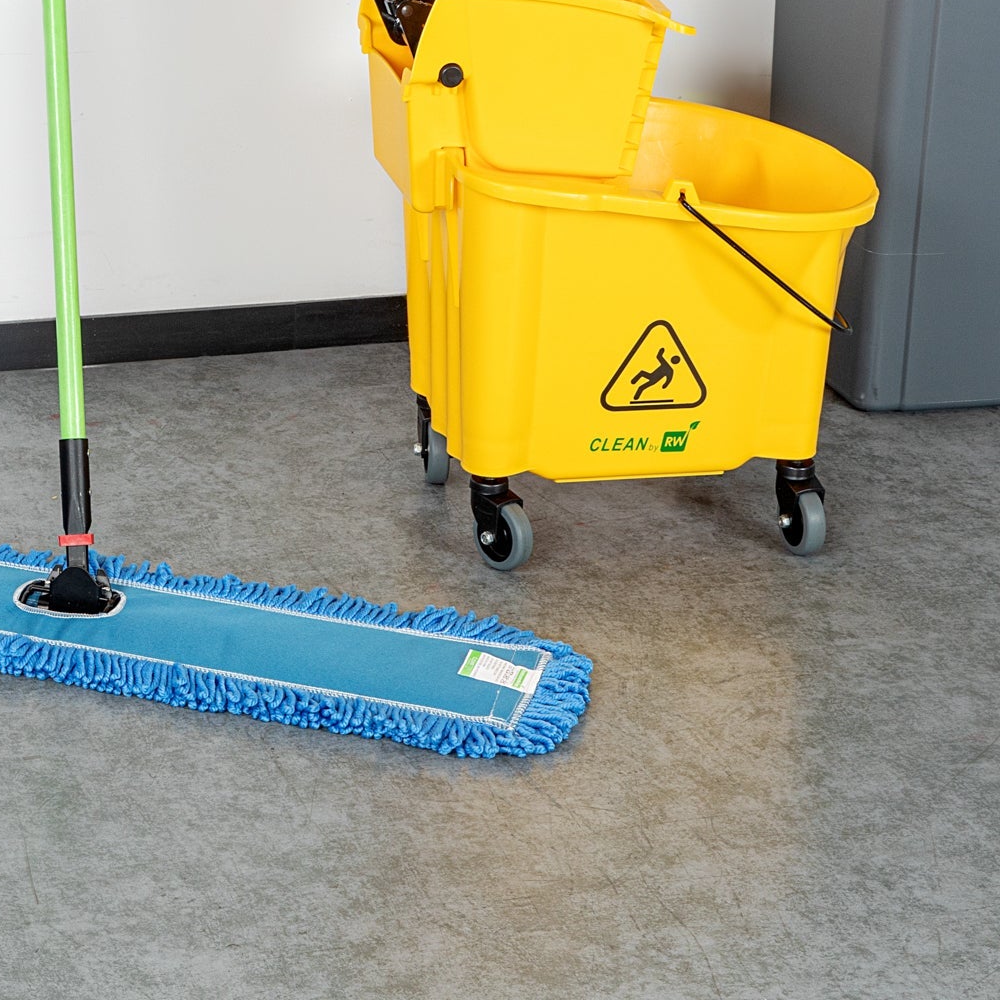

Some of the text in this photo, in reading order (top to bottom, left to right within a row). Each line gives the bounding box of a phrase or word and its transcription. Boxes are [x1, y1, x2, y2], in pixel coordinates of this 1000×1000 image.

[589, 436, 687, 453] CLEAN by RW
